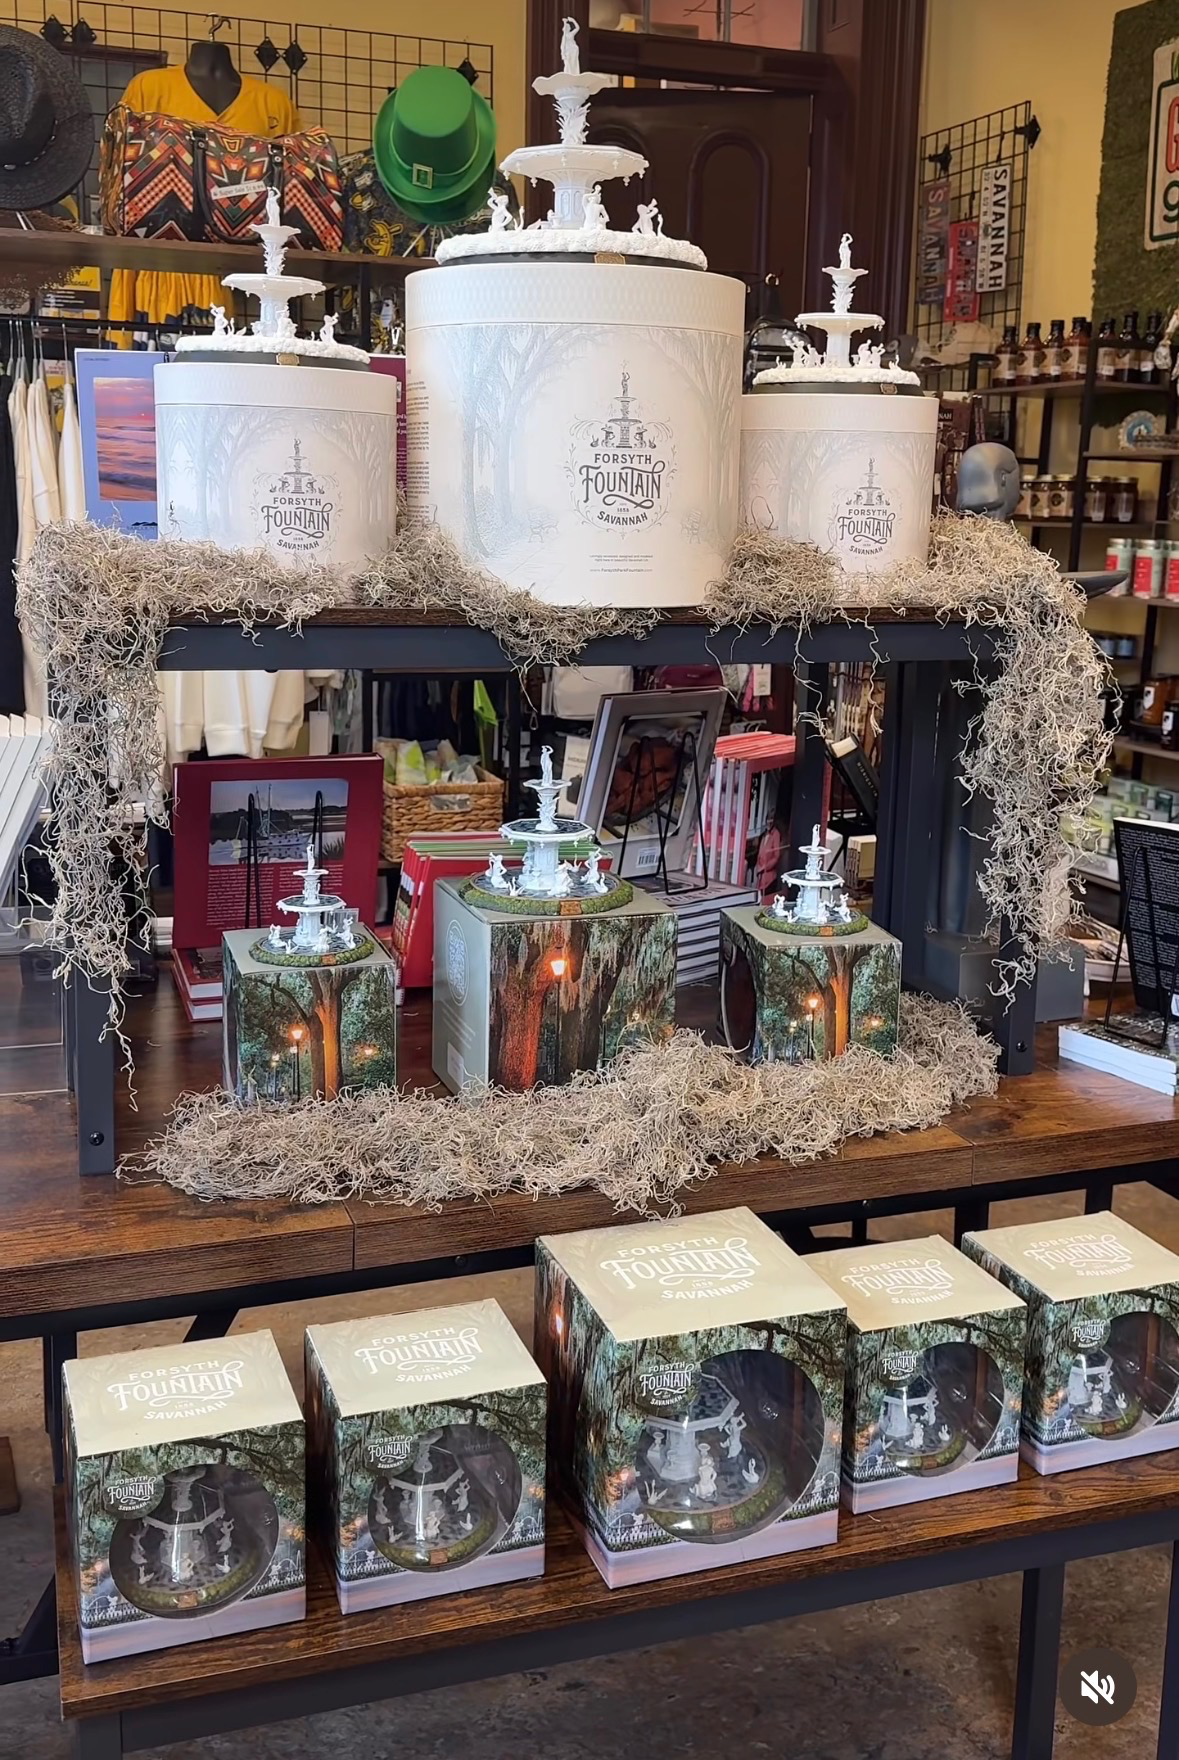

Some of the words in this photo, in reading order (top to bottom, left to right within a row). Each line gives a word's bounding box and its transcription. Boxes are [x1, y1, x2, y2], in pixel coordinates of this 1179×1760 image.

[988, 168, 1008, 289] SAVANNAH
[922, 188, 945, 301] SAVANNAH
[594, 453, 652, 465] FORSYTH
[579, 460, 666, 504] FOUNTAIN
[273, 497, 322, 506] FORSYTH
[261, 502, 334, 534] FOUNTAIN
[597, 510, 648, 526] SAVANNAH
[838, 512, 896, 540] FOUNTAIN
[276, 539, 320, 551] SAVANNAH
[849, 545, 883, 555] SAVANNAH
[617, 1236, 719, 1258] FORSYTH
[1022, 1234, 1134, 1270] FOUNTAIN
[1030, 1234, 1097, 1249] FORSYTH
[600, 1237, 762, 1290] FOUNTAIN
[849, 1258, 921, 1274] FORSYTH
[1076, 1262, 1135, 1277] SAVANNAH
[840, 1258, 955, 1298] FOUNTAIN
[660, 1279, 754, 1300] SAVANNAH
[890, 1289, 955, 1305] SAVANNAH
[372, 1327, 456, 1347] FORSYTH
[354, 1327, 484, 1375] FOUNTAIN
[128, 1360, 220, 1382] FORSYTH
[395, 1364, 472, 1383] SAVANNAH
[648, 1360, 686, 1374] FORSYTH
[882, 1350, 919, 1375] FOUNTAIN
[106, 1360, 245, 1412] FOUNTAIN
[640, 1363, 695, 1397] FOUNTAIN
[143, 1401, 228, 1420] SAVANNAH
[650, 1395, 683, 1406] SAVANNAH
[368, 1436, 413, 1463] FOUNTAIN
[107, 1476, 157, 1505] FOUNTAIN
